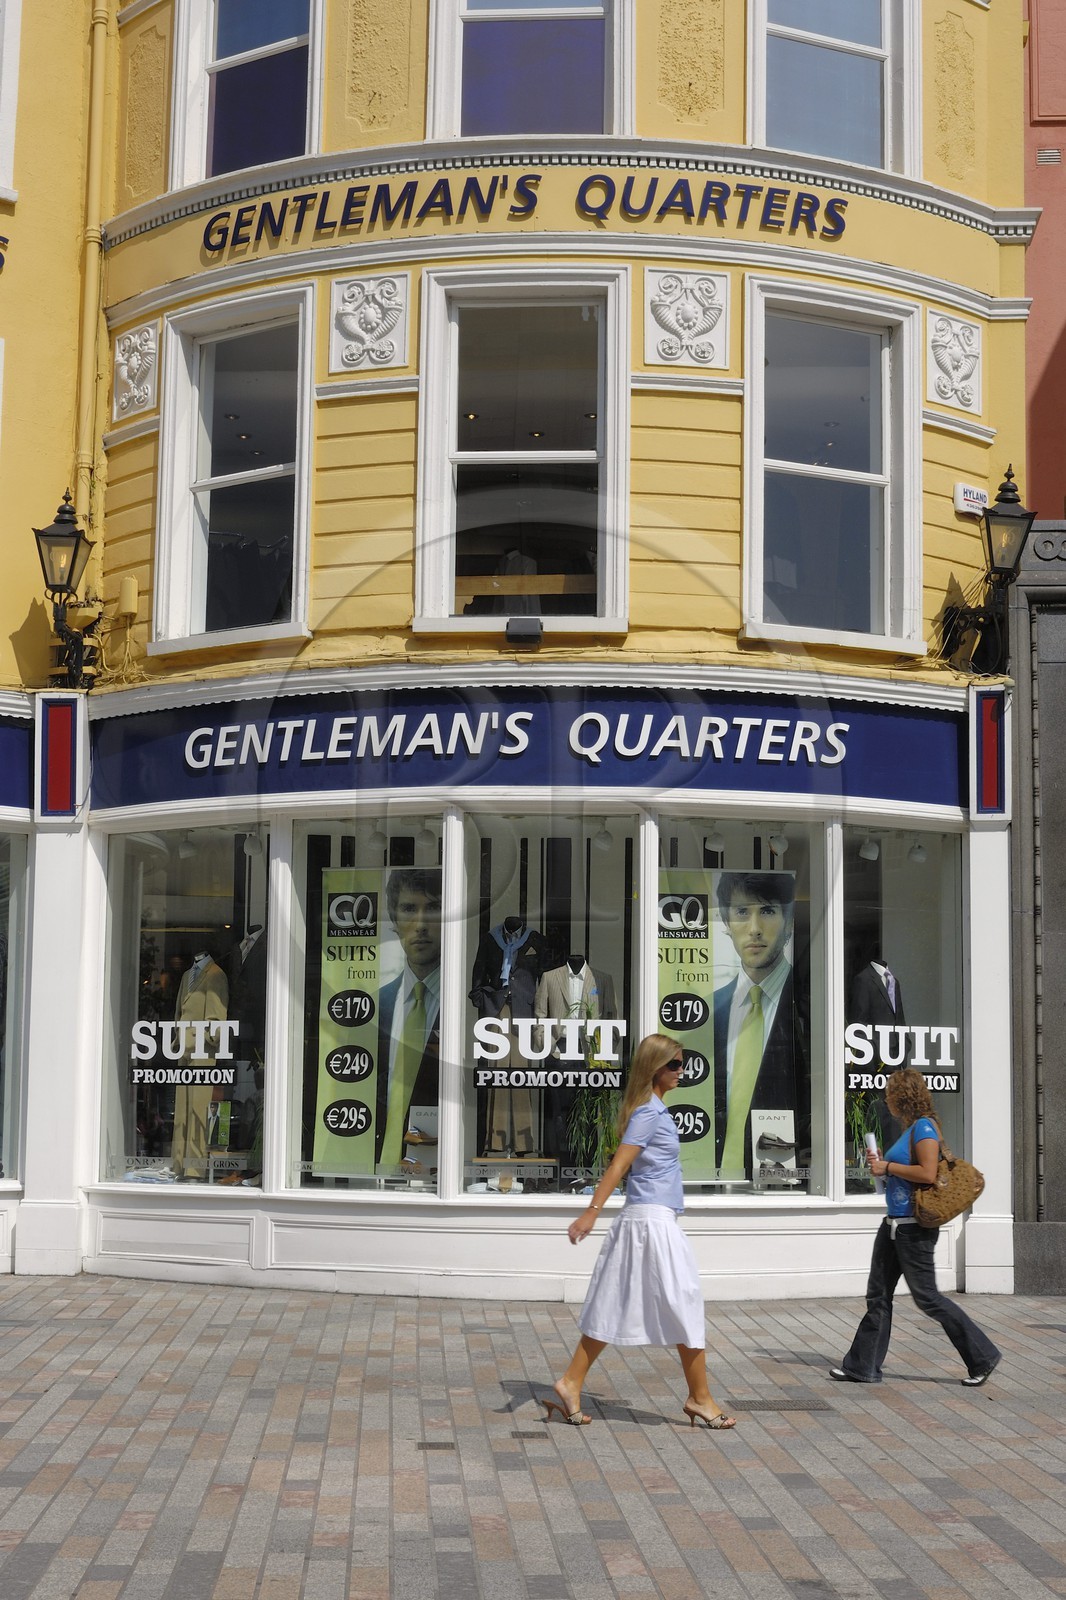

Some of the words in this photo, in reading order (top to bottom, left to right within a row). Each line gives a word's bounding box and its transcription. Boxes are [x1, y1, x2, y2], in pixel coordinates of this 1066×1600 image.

[203, 174, 542, 251] GENTLEMAN'S
[577, 174, 849, 236] QUARTERS
[963, 488, 987, 503] HYLAND
[184, 712, 533, 769] GENTLEMAN'S
[569, 712, 850, 764] QUARTERS
[329, 895, 376, 928] GQ
[658, 896, 707, 931] GQ
[326, 945, 377, 961] SUITS
[658, 947, 709, 964] SUITS
[347, 966, 376, 979] from
[676, 969, 709, 982] from
[331, 997, 371, 1019] €179
[661, 1000, 703, 1023] €179
[131, 1020, 239, 1060] SUIT
[473, 1017, 626, 1060] SUIT
[844, 1023, 957, 1066] SUIT
[330, 1053, 369, 1075] €249
[678, 1057, 704, 1080] 49
[132, 1069, 235, 1084] PROMOTION
[476, 1070, 622, 1087] PROMOTION
[849, 1074, 958, 1090] PROION
[327, 1107, 366, 1129] €295
[213, 1160, 240, 1168] GROSS
